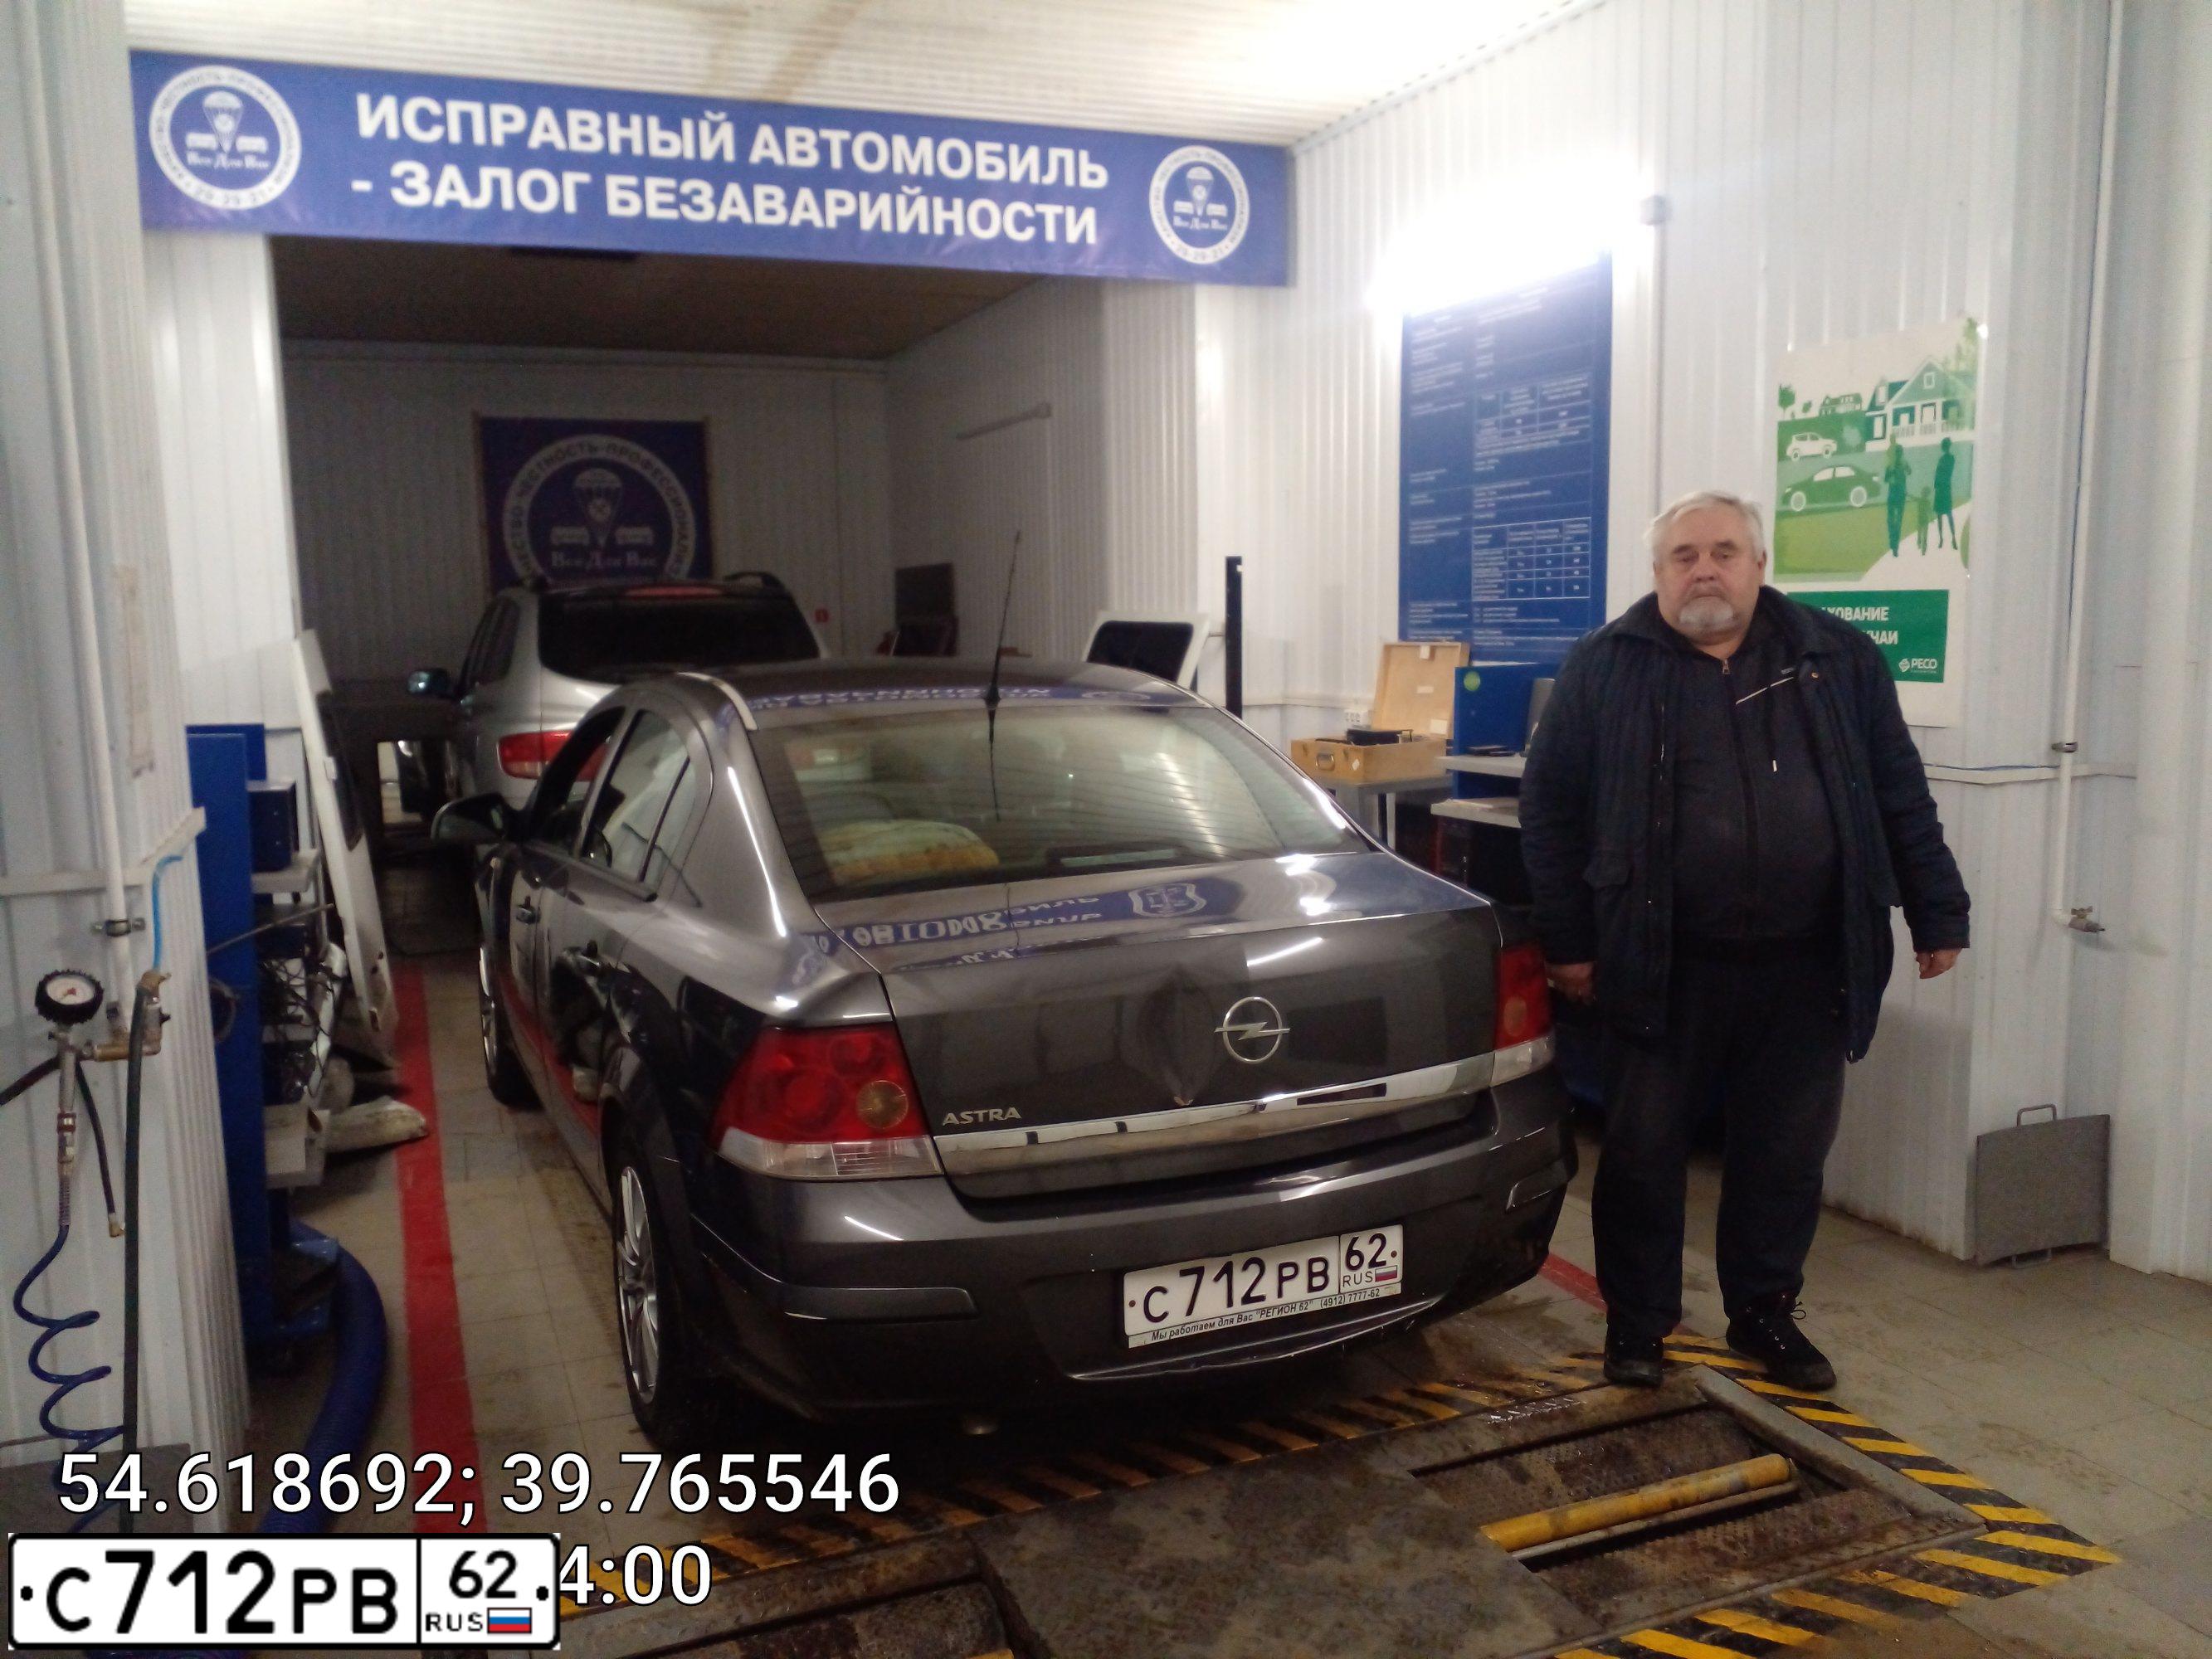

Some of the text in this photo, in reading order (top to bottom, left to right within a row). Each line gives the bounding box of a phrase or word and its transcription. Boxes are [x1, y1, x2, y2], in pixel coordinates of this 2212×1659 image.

[355, 92, 736, 163] ИСПРАВНЫЙ
[749, 123, 1109, 189] АВТОМОБИЛЬ
[389, 160, 592, 213] ЗАЛОГ
[605, 173, 1099, 245] БЕЗАВАРИЙНОСТИ
[943, 1107, 1022, 1126] ASTRA
[1344, 1233, 1387, 1271] 62
[1143, 1257, 1330, 1323] С712РВ
[1342, 1271, 1373, 1288] RUS
[1151, 1331, 1167, 1341] Мы
[1168, 1321, 1216, 1340] работаем
[1217, 1316, 1235, 1328] для
[1236, 1314, 1254, 1324] Вас
[1319, 1295, 1346, 1309] (4912)
[1347, 1288, 1381, 1302] 7777-62
